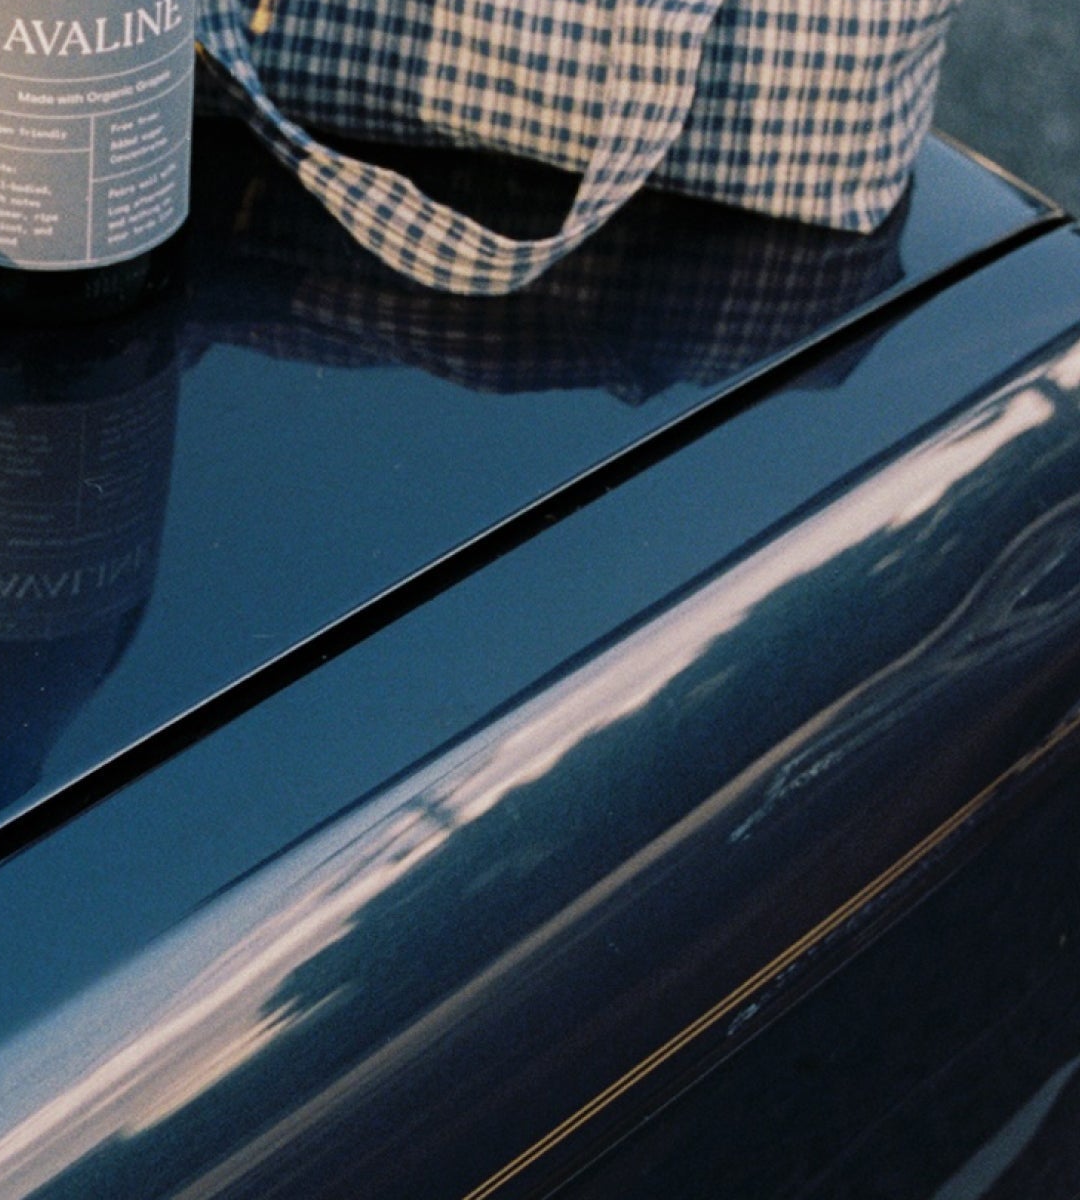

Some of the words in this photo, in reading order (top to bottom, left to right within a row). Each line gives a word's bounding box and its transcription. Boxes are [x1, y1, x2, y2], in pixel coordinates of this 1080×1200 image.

[18, 90, 54, 104] Made
[57, 93, 84, 104] with
[86, 85, 134, 103] Organic
